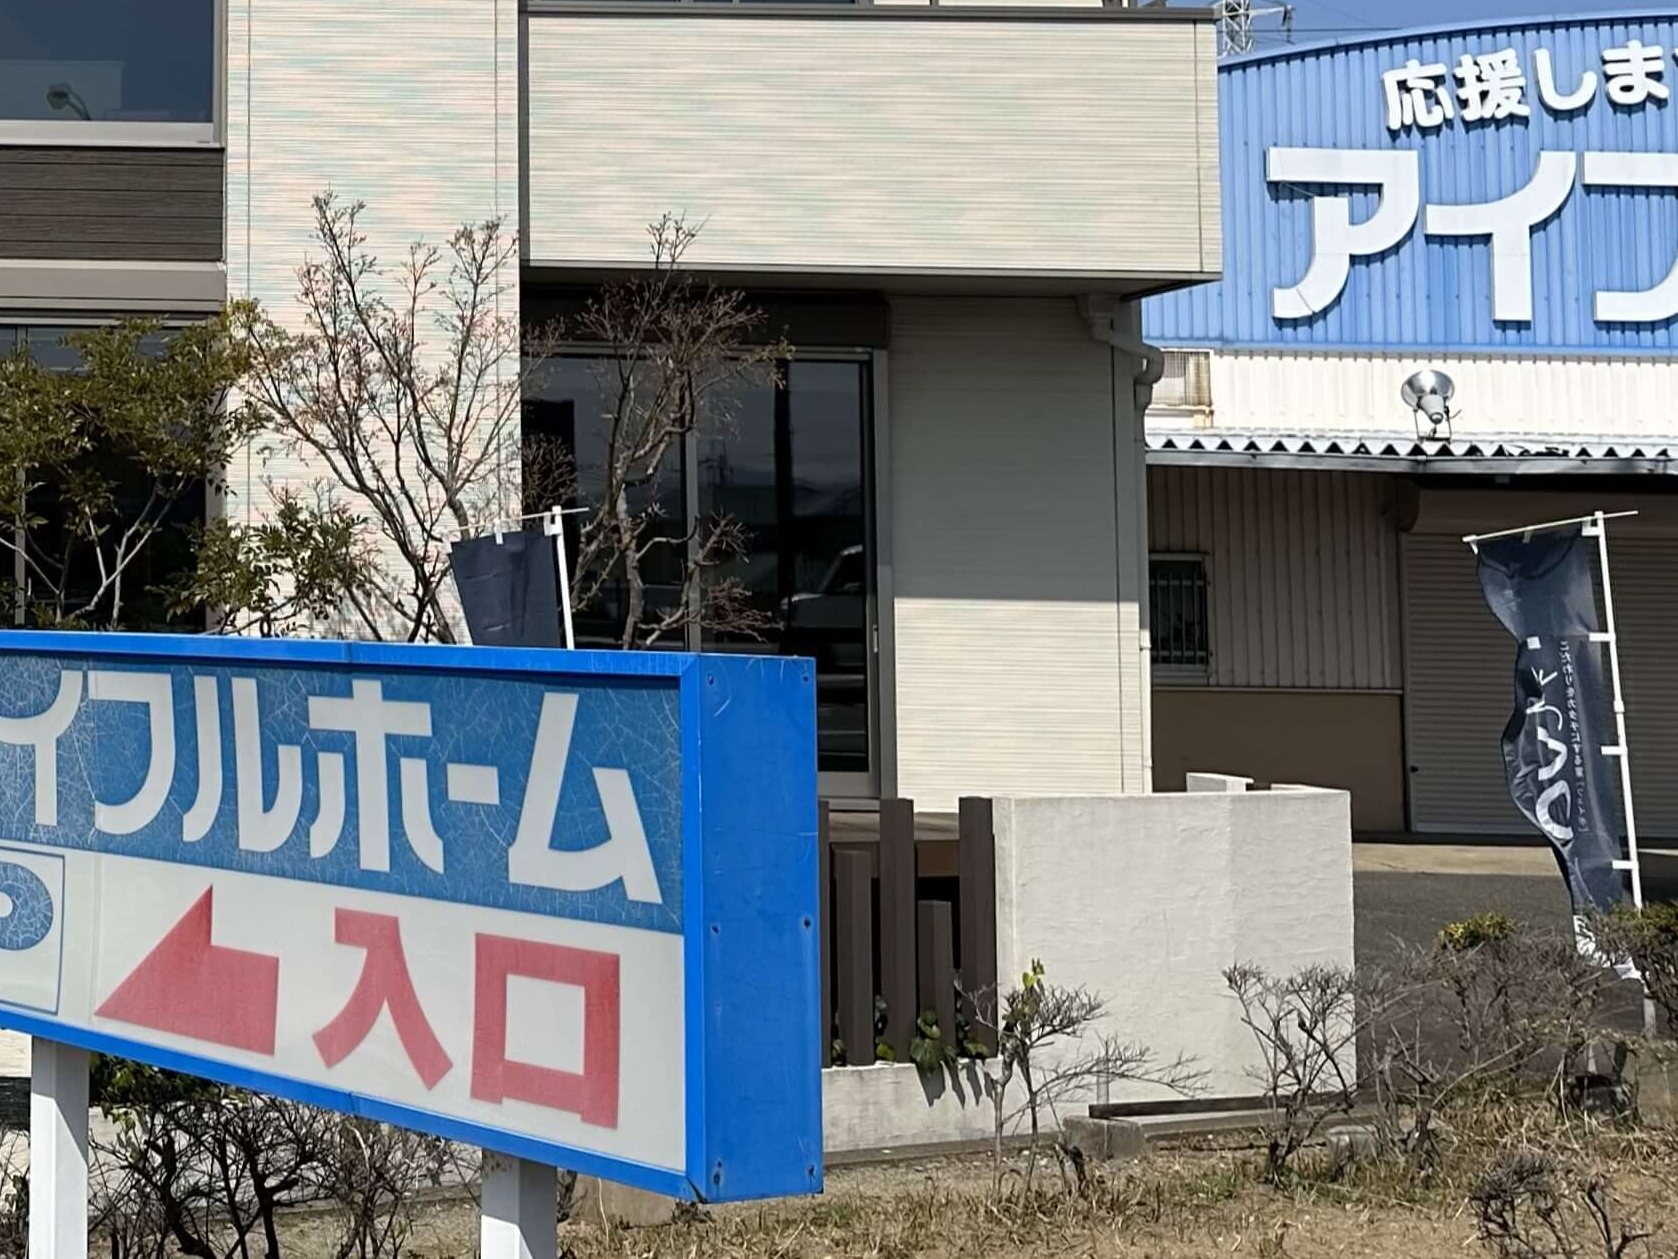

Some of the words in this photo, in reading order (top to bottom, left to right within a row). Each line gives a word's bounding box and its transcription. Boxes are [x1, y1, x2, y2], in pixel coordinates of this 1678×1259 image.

[1382, 40, 1678, 131] 応援しま
[312, 907, 621, 1129] 入口
